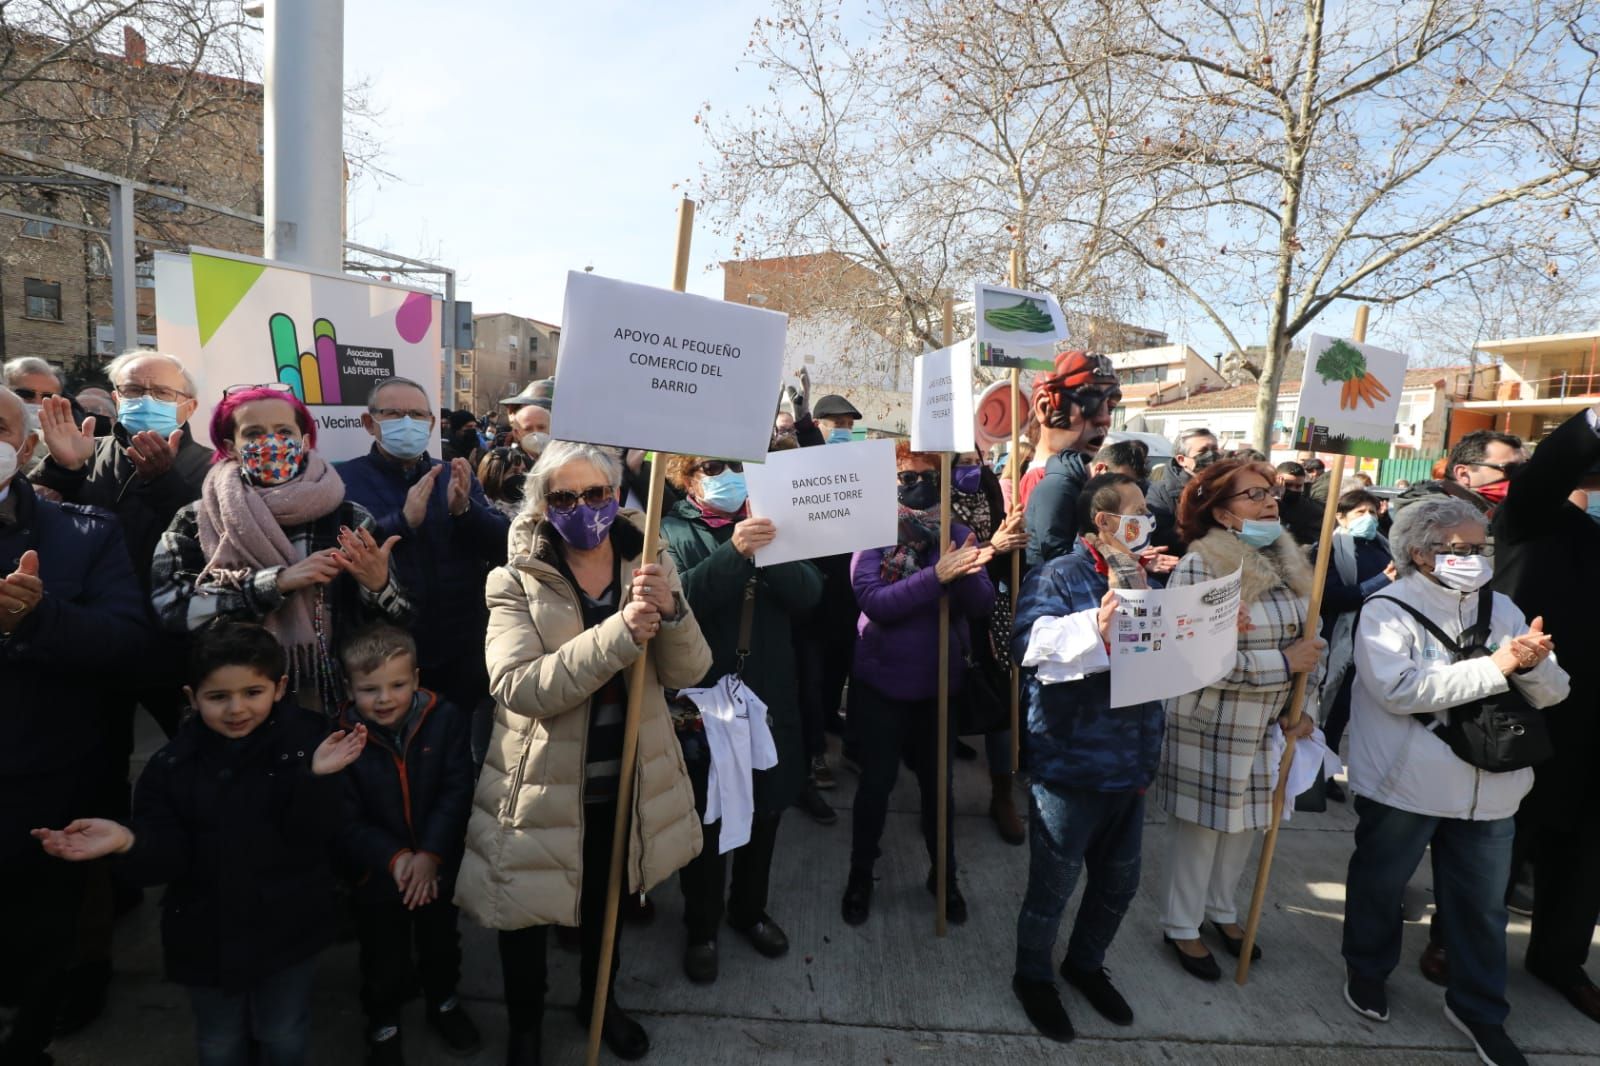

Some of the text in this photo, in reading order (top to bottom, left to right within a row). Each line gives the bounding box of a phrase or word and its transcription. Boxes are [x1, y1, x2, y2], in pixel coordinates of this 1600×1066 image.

[613, 327, 742, 359] APOYO AL PEQUEÑO
[346, 348, 383, 359] Asociación
[343, 366, 390, 376] LAS FUENTES
[353, 358, 378, 367] Vecinal
[629, 352, 723, 378] COMERCIO DEL
[651, 377, 698, 395] BARRIO
[792, 472, 860, 489] BANCOS EN EL
[791, 489, 864, 507] PARQUE TORRE
[808, 507, 851, 522] RAMONA
